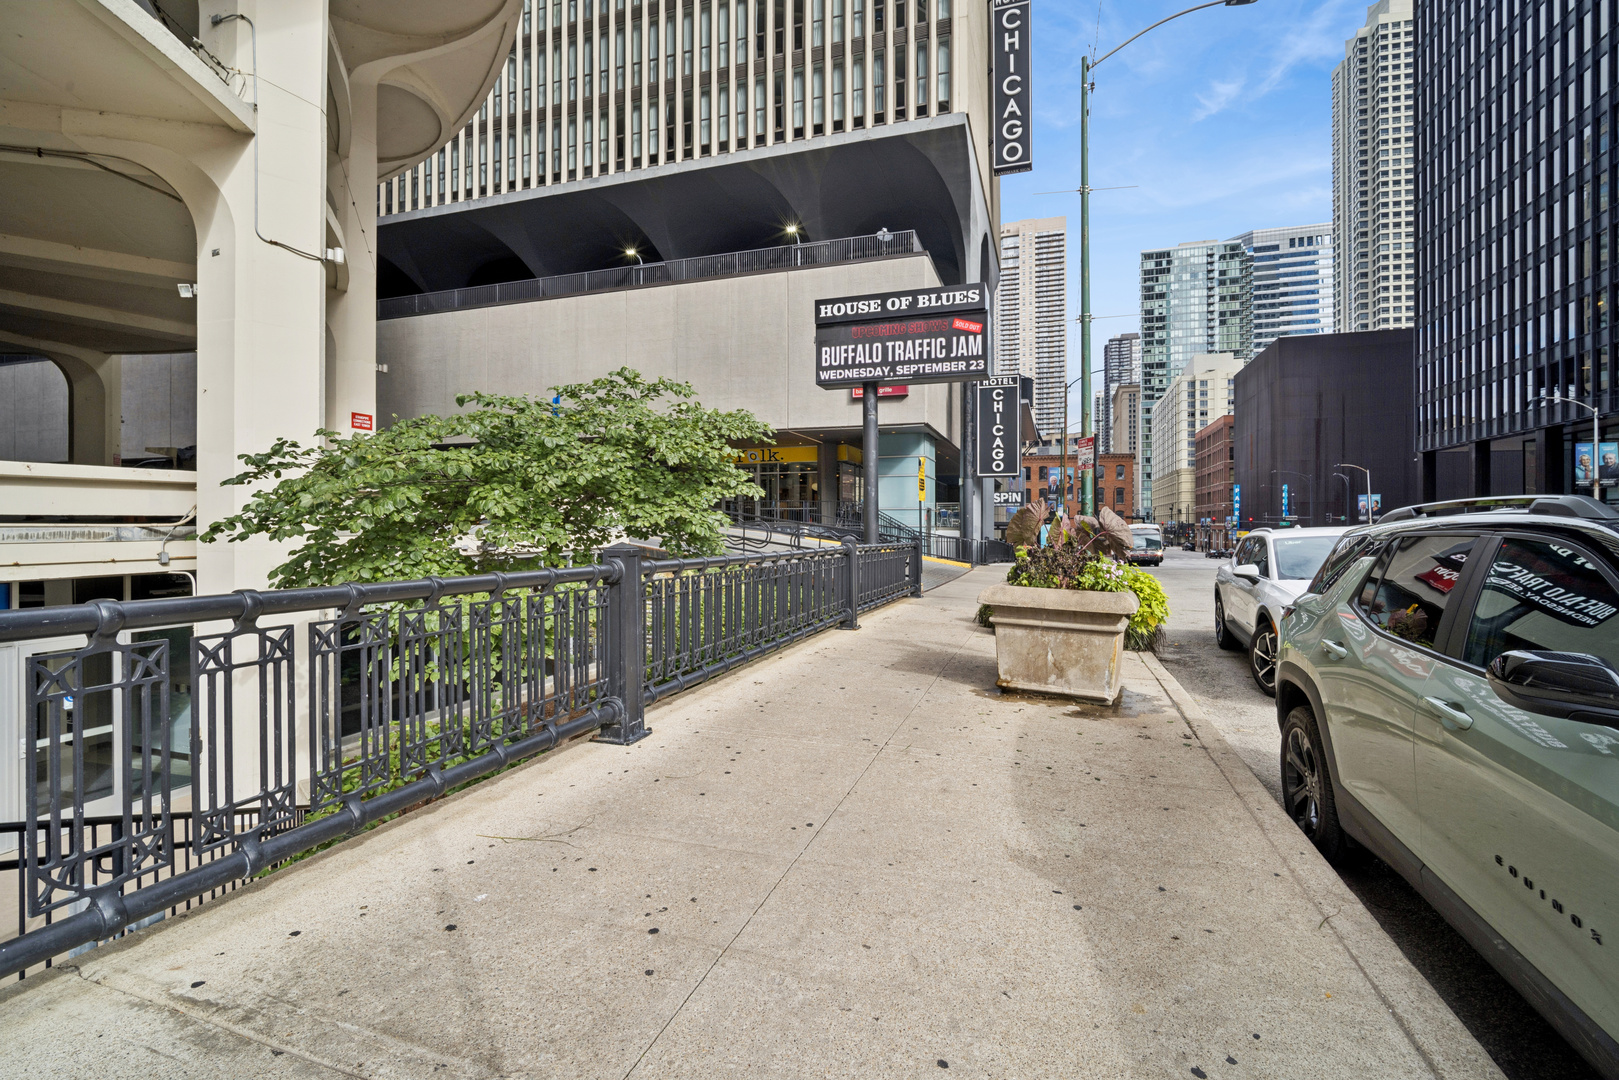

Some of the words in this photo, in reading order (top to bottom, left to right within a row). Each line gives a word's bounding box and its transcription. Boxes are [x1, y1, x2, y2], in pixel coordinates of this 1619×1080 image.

[1002, 8, 1023, 162] CHICAGO
[820, 300, 881, 317] HOUSE
[886, 296, 912, 311] OF
[917, 289, 980, 308] BLUES
[852, 322, 906, 339] UPCOMING
[908, 319, 949, 334] SHOWS
[955, 320, 969, 329] SOLD
[969, 323, 980, 332] OUT
[822, 343, 882, 367] BUFFALO
[886, 337, 946, 362] TRAFFIC
[950, 335, 983, 357] JAM
[820, 366, 894, 380] WEDNESDAY,
[896, 361, 967, 375] SEPTEMBER
[969, 360, 985, 370] 23
[983, 378, 1014, 386] HOTEL
[992, 389, 1004, 472] CHICAGO
